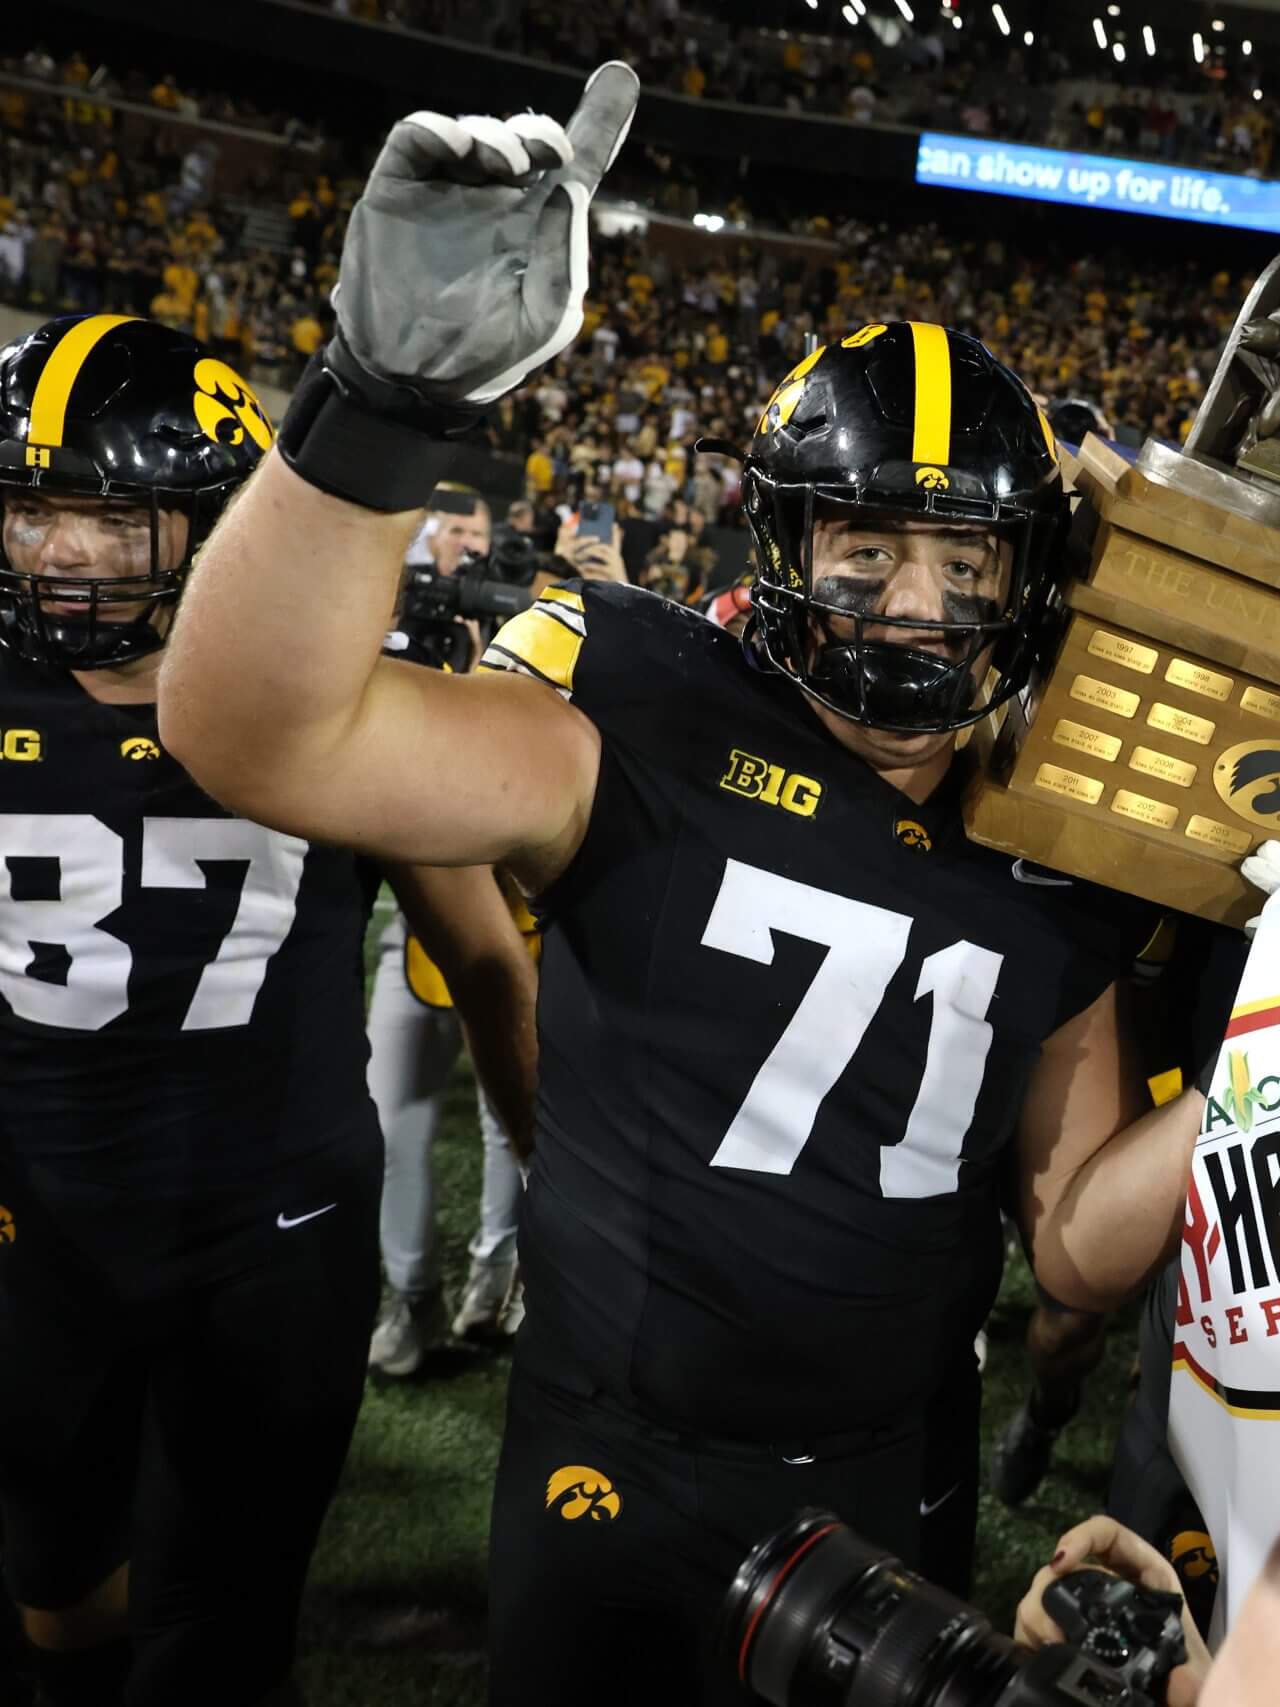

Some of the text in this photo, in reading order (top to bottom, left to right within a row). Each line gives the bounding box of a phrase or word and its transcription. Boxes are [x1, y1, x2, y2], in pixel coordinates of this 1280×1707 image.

[976, 151, 1062, 190] show
[1068, 168, 1111, 202] up
[1116, 169, 1166, 204] for
[1169, 175, 1231, 215] life.
[1125, 551, 1195, 597] THE
[1115, 641, 1135, 654] 1997
[1095, 686, 1117, 699] 2003
[1078, 730, 1100, 743] 2007
[1062, 774, 1080, 786] 2011
[1136, 801, 1157, 813] 2012
[0, 813, 310, 1032] 87
[700, 857, 1004, 1199] 71
